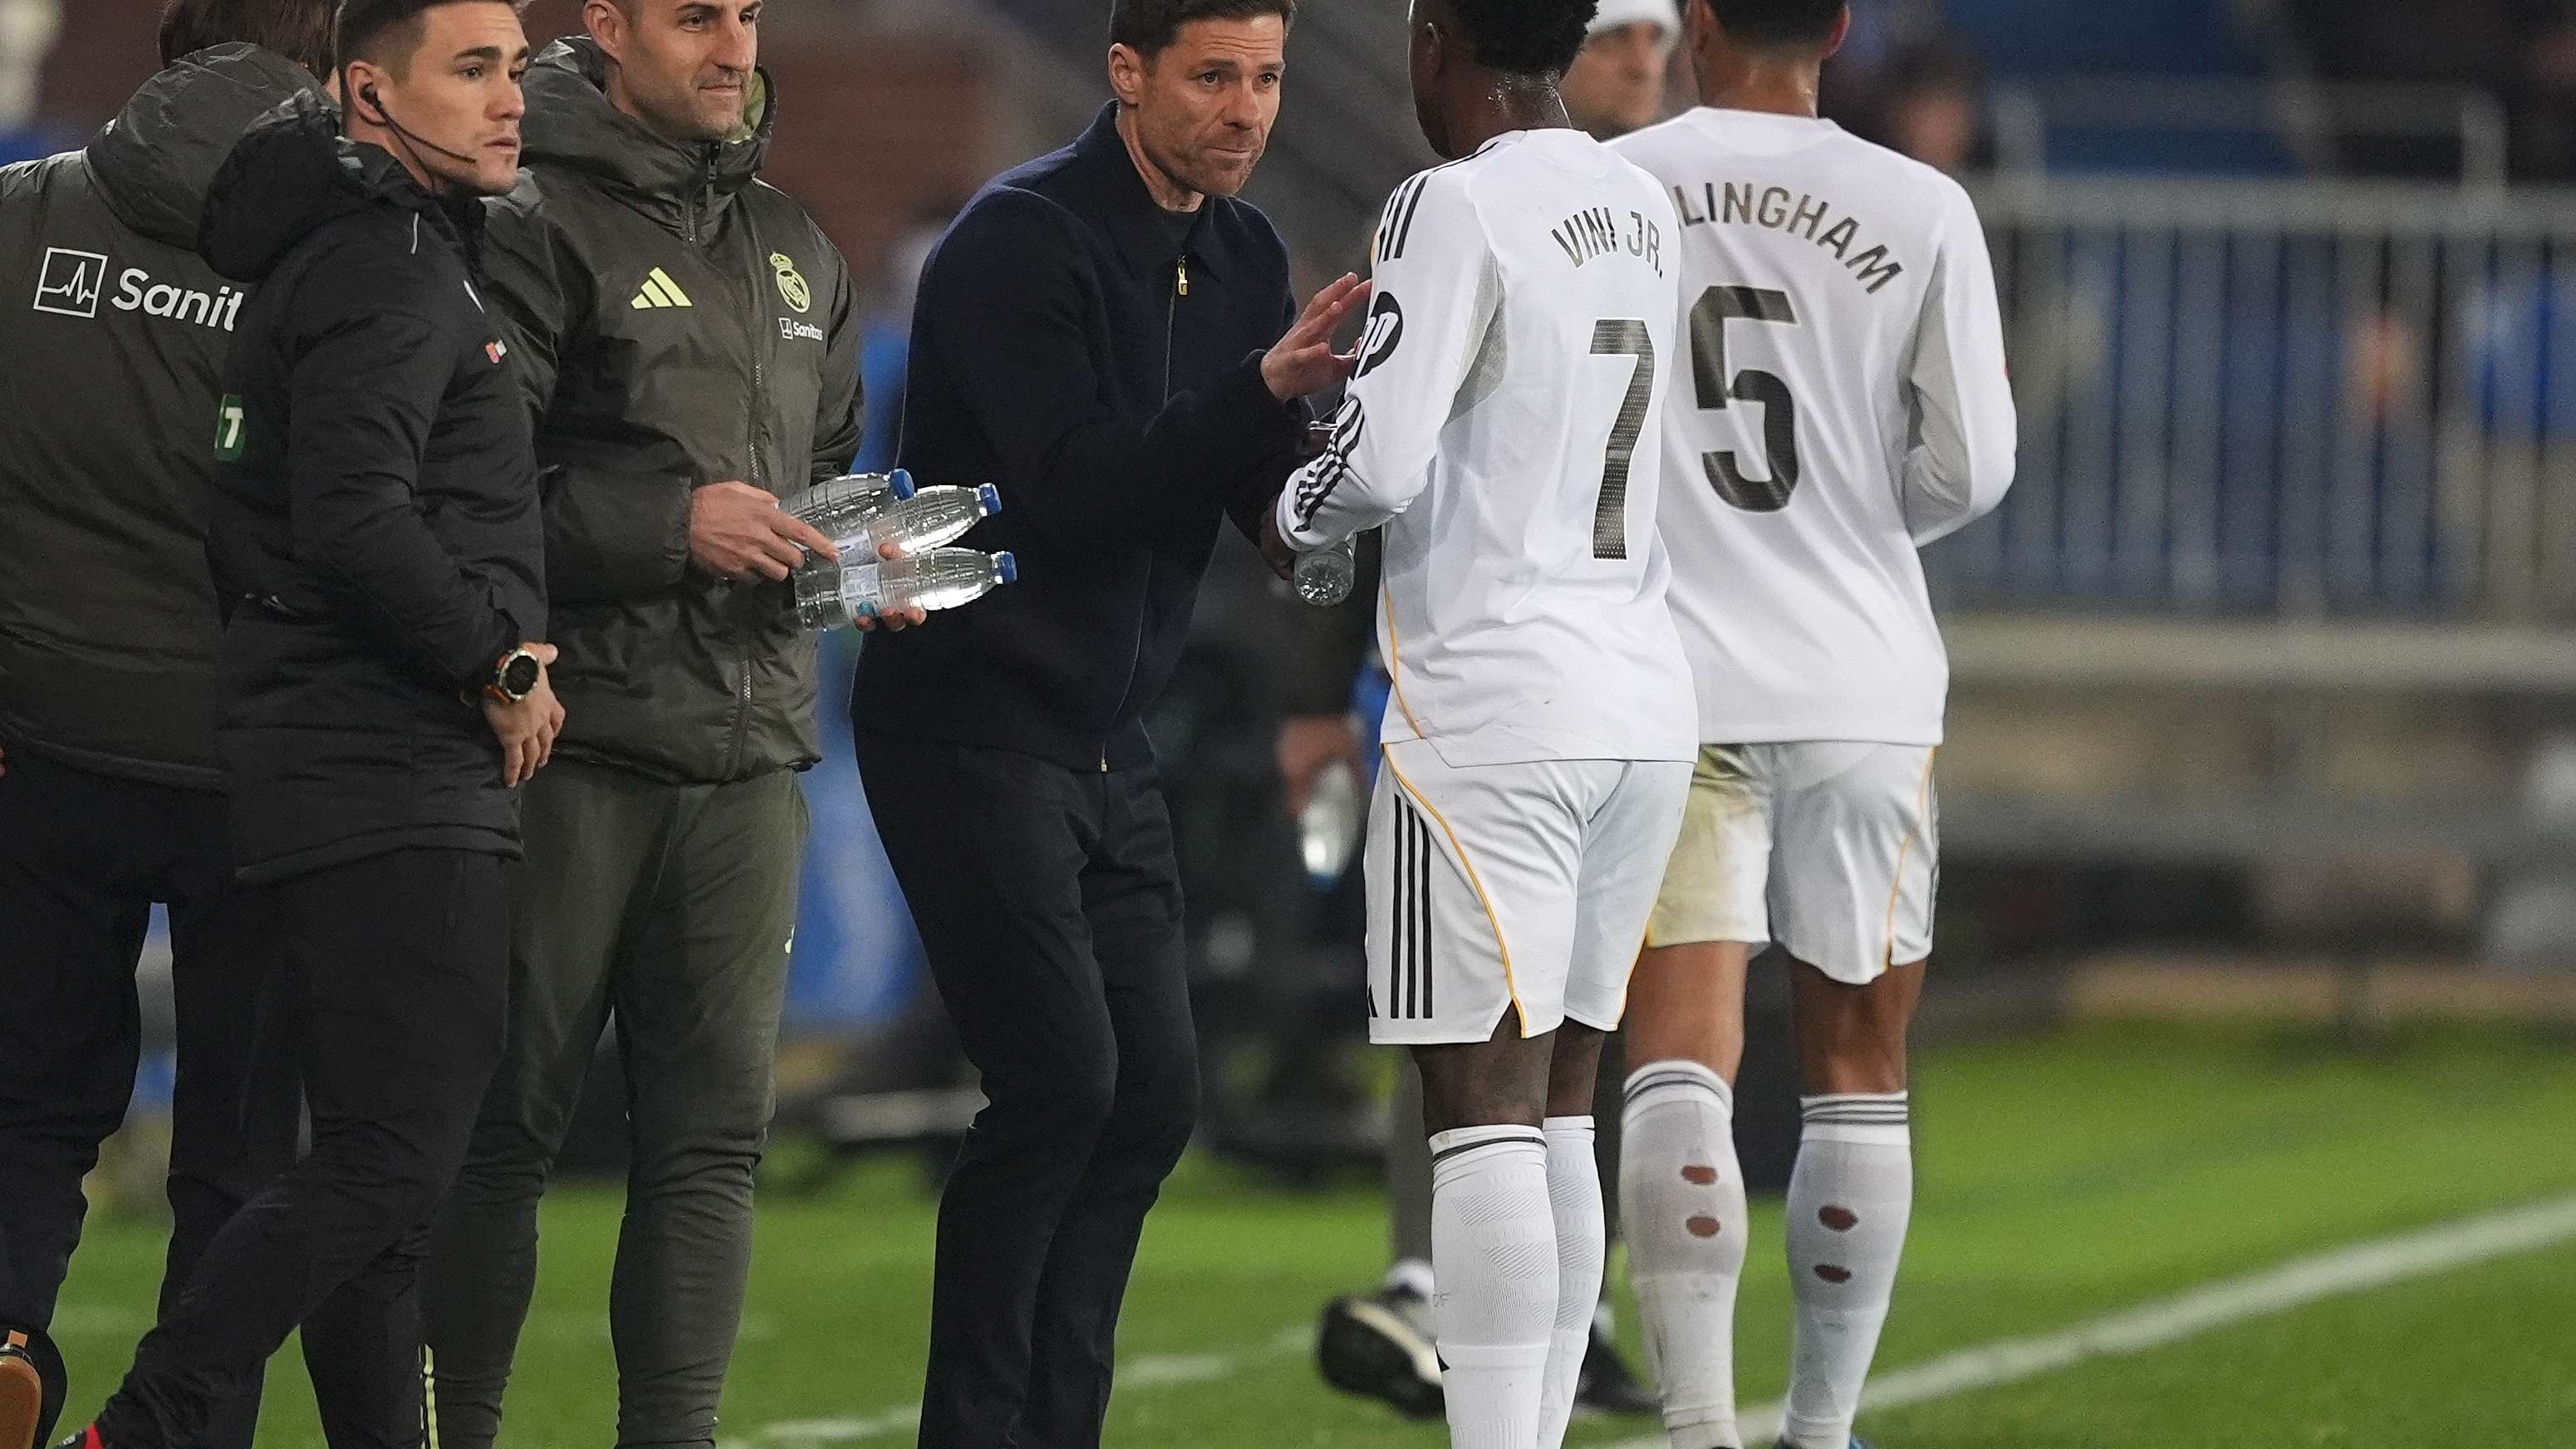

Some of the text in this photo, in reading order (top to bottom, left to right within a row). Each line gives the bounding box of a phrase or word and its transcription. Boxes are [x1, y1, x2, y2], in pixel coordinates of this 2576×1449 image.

[1551, 207, 1663, 280] VINI JR.
[1674, 182, 1903, 294] LINGHAM
[111, 268, 244, 332] Sanit
[792, 322, 822, 341] Sanitas
[1589, 319, 1655, 560] 7
[1690, 285, 1798, 513] 5
